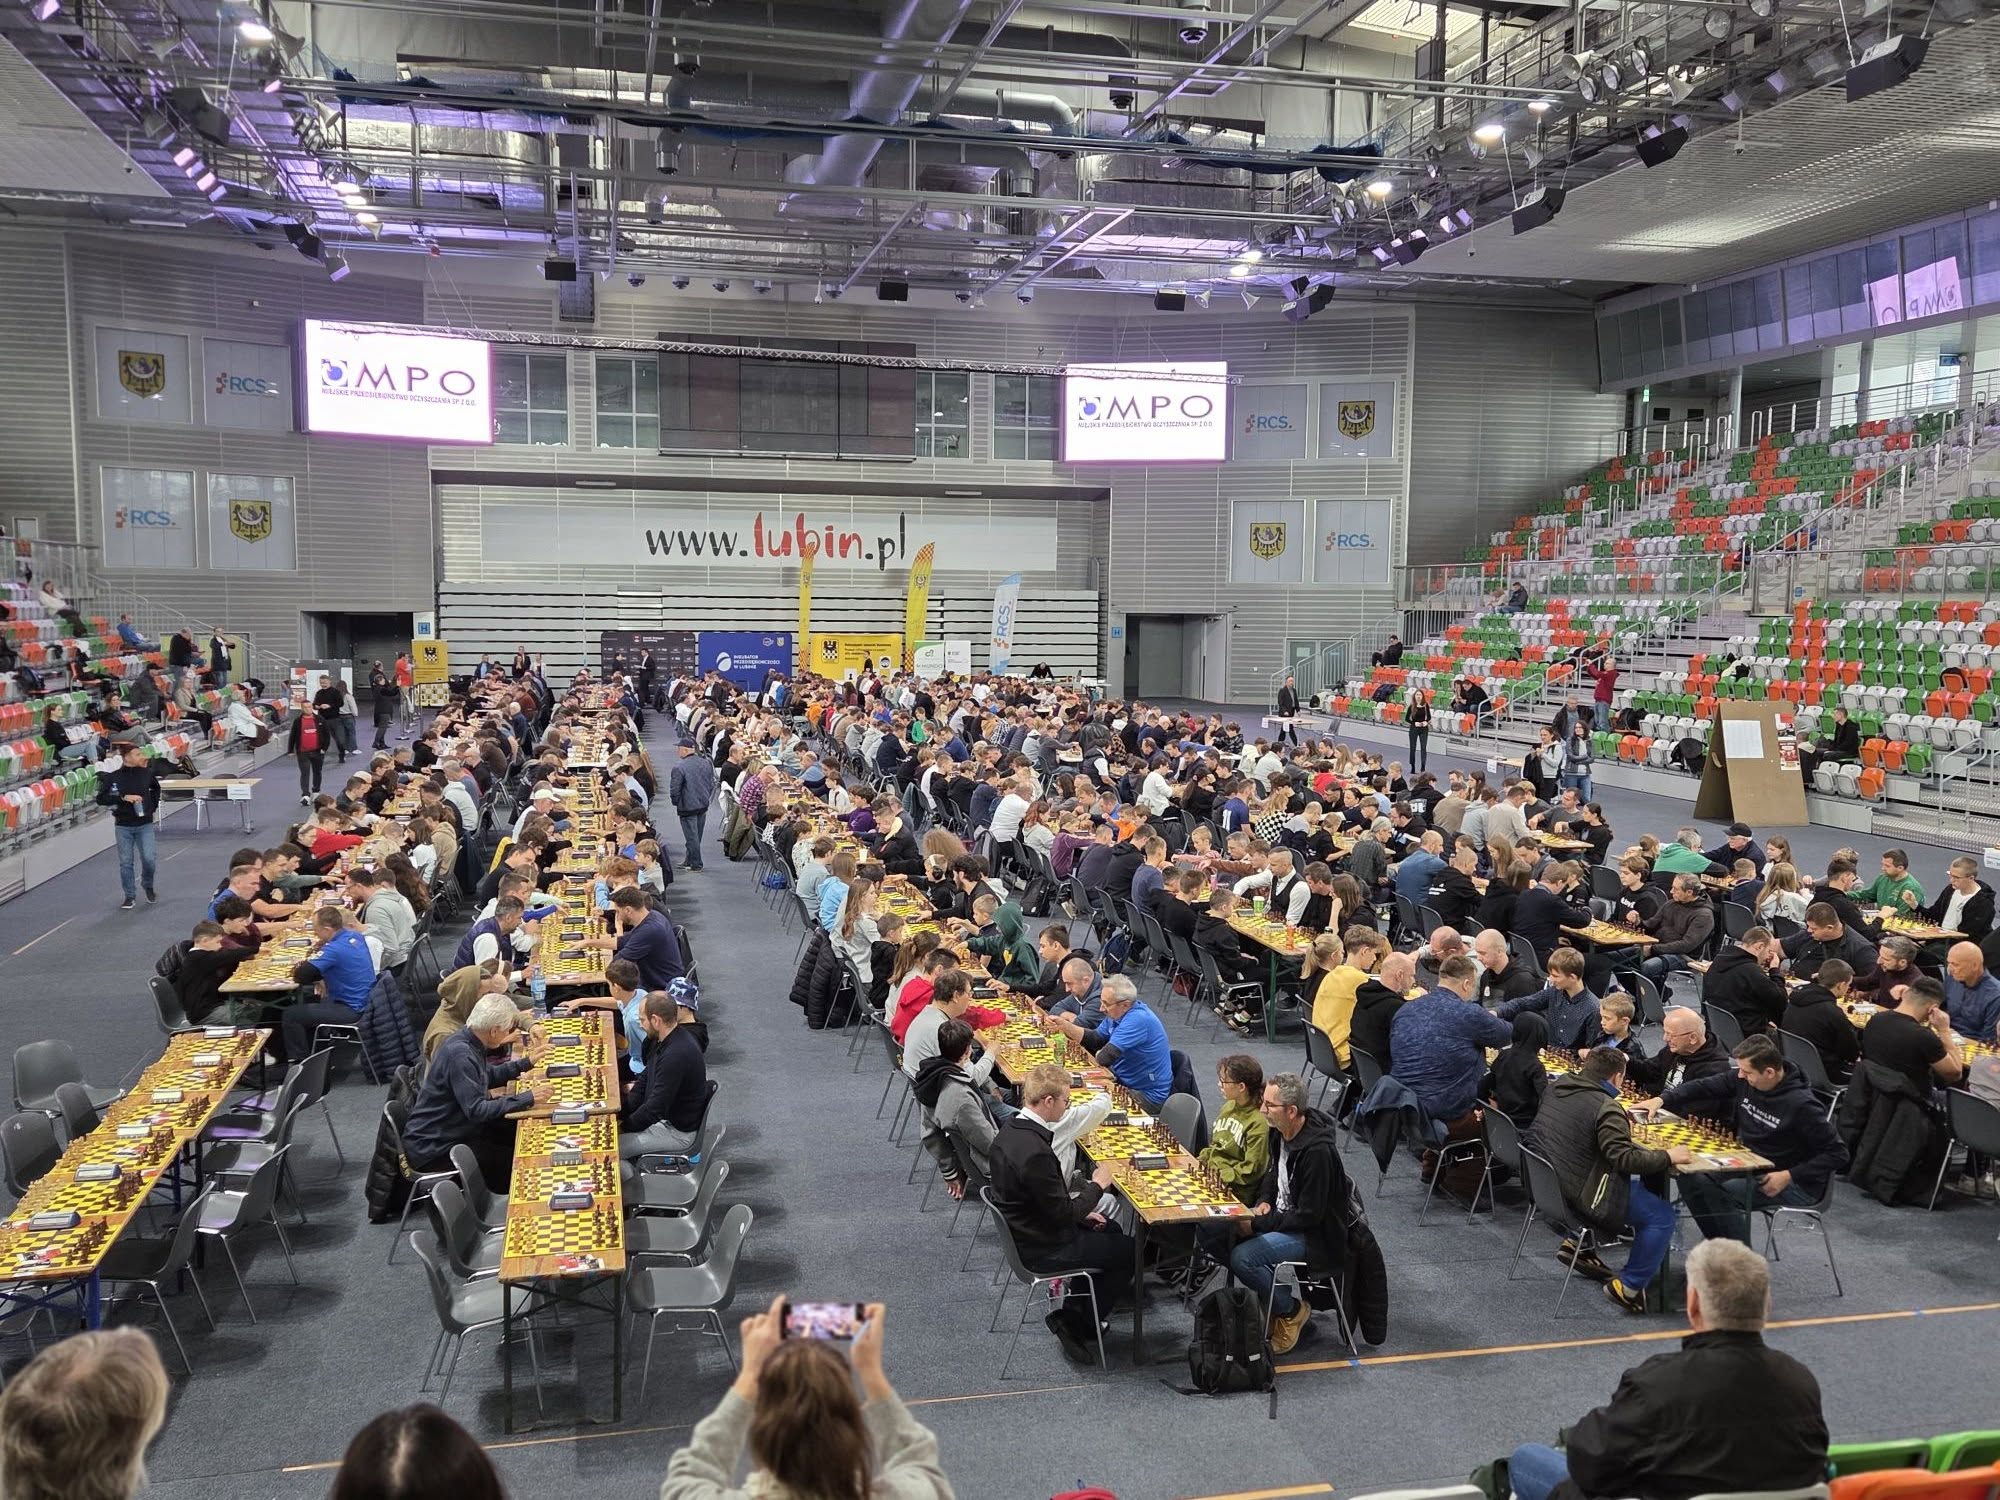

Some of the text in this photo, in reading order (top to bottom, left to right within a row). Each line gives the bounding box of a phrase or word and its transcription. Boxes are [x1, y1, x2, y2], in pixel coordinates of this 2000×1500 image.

[354, 361, 476, 396] MPO
[1106, 395, 1213, 420] MPO
[645, 511, 906, 571] www.lubin.pl
